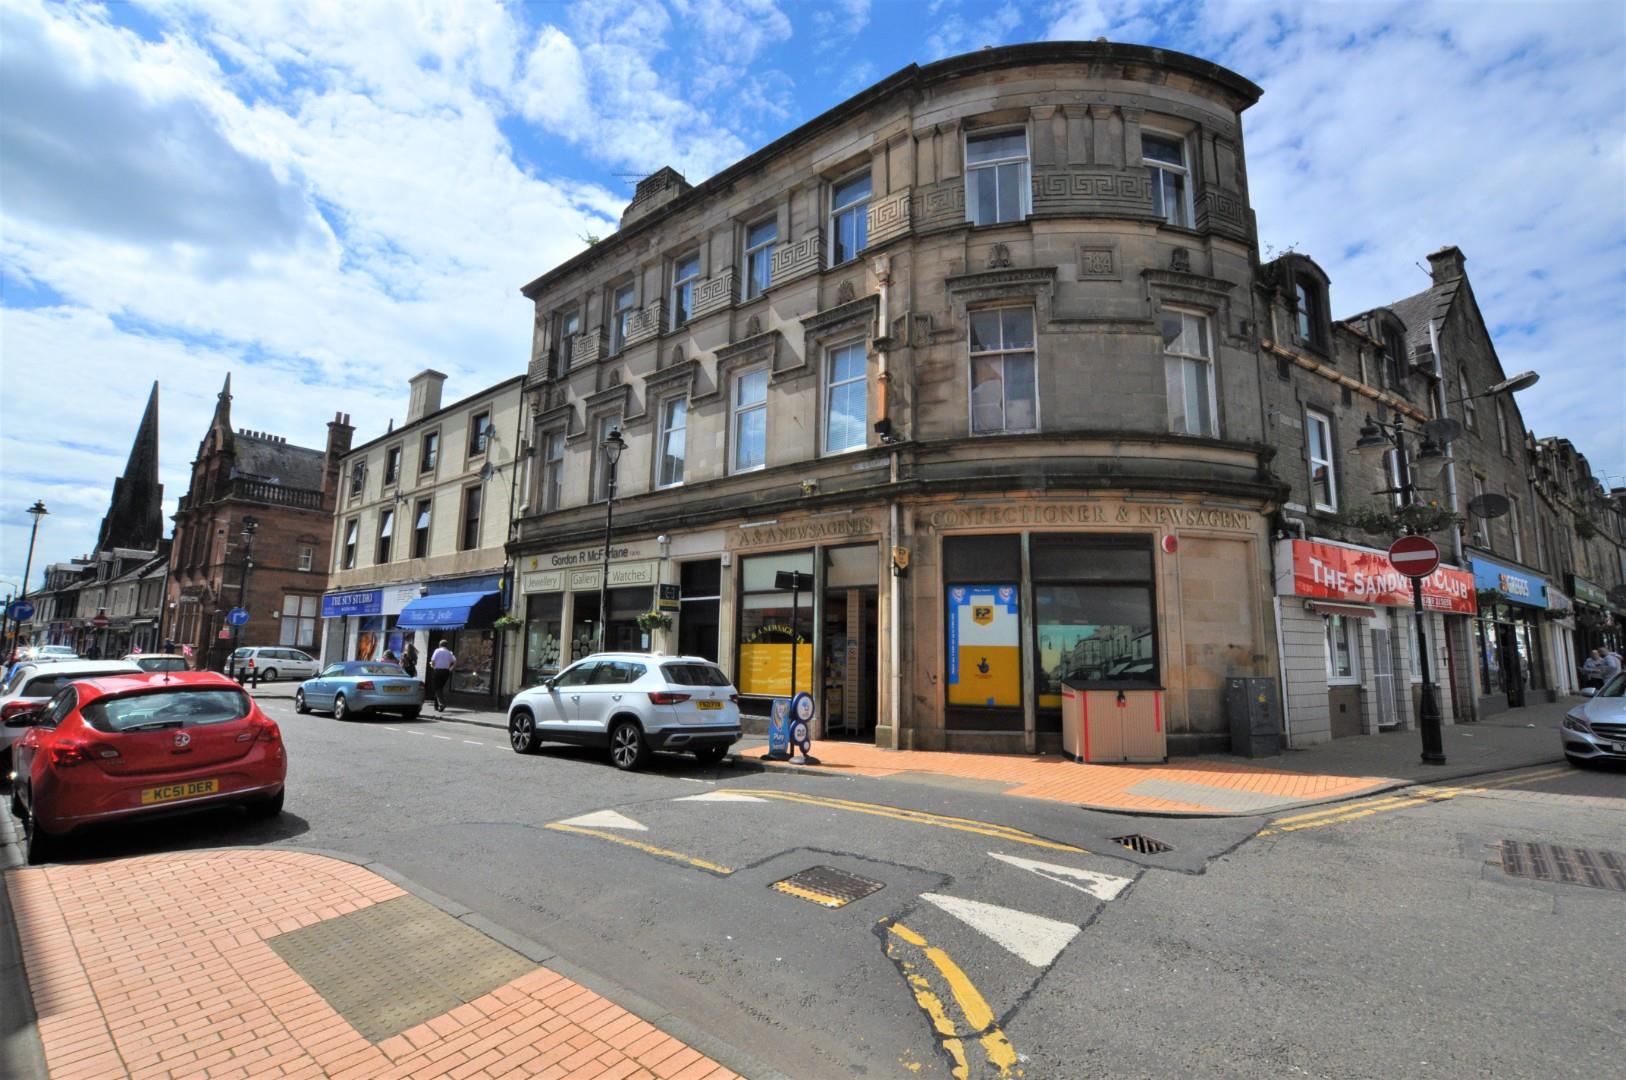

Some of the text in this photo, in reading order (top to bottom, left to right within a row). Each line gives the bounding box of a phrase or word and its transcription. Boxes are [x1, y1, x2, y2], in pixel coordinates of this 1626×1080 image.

[930, 504, 1250, 529] CONFECTIONER & NEWSAGENT
[740, 516, 873, 546] A & A NEWSAGENTS
[551, 554, 577, 566] Gordon
[579, 551, 587, 562] R
[528, 576, 557, 587] Jewellery
[572, 573, 597, 586] Gallery
[613, 569, 646, 583] Watches
[1309, 556, 1348, 592] THE
[1434, 569, 1468, 599] CLUB
[188, 781, 214, 795] DER
